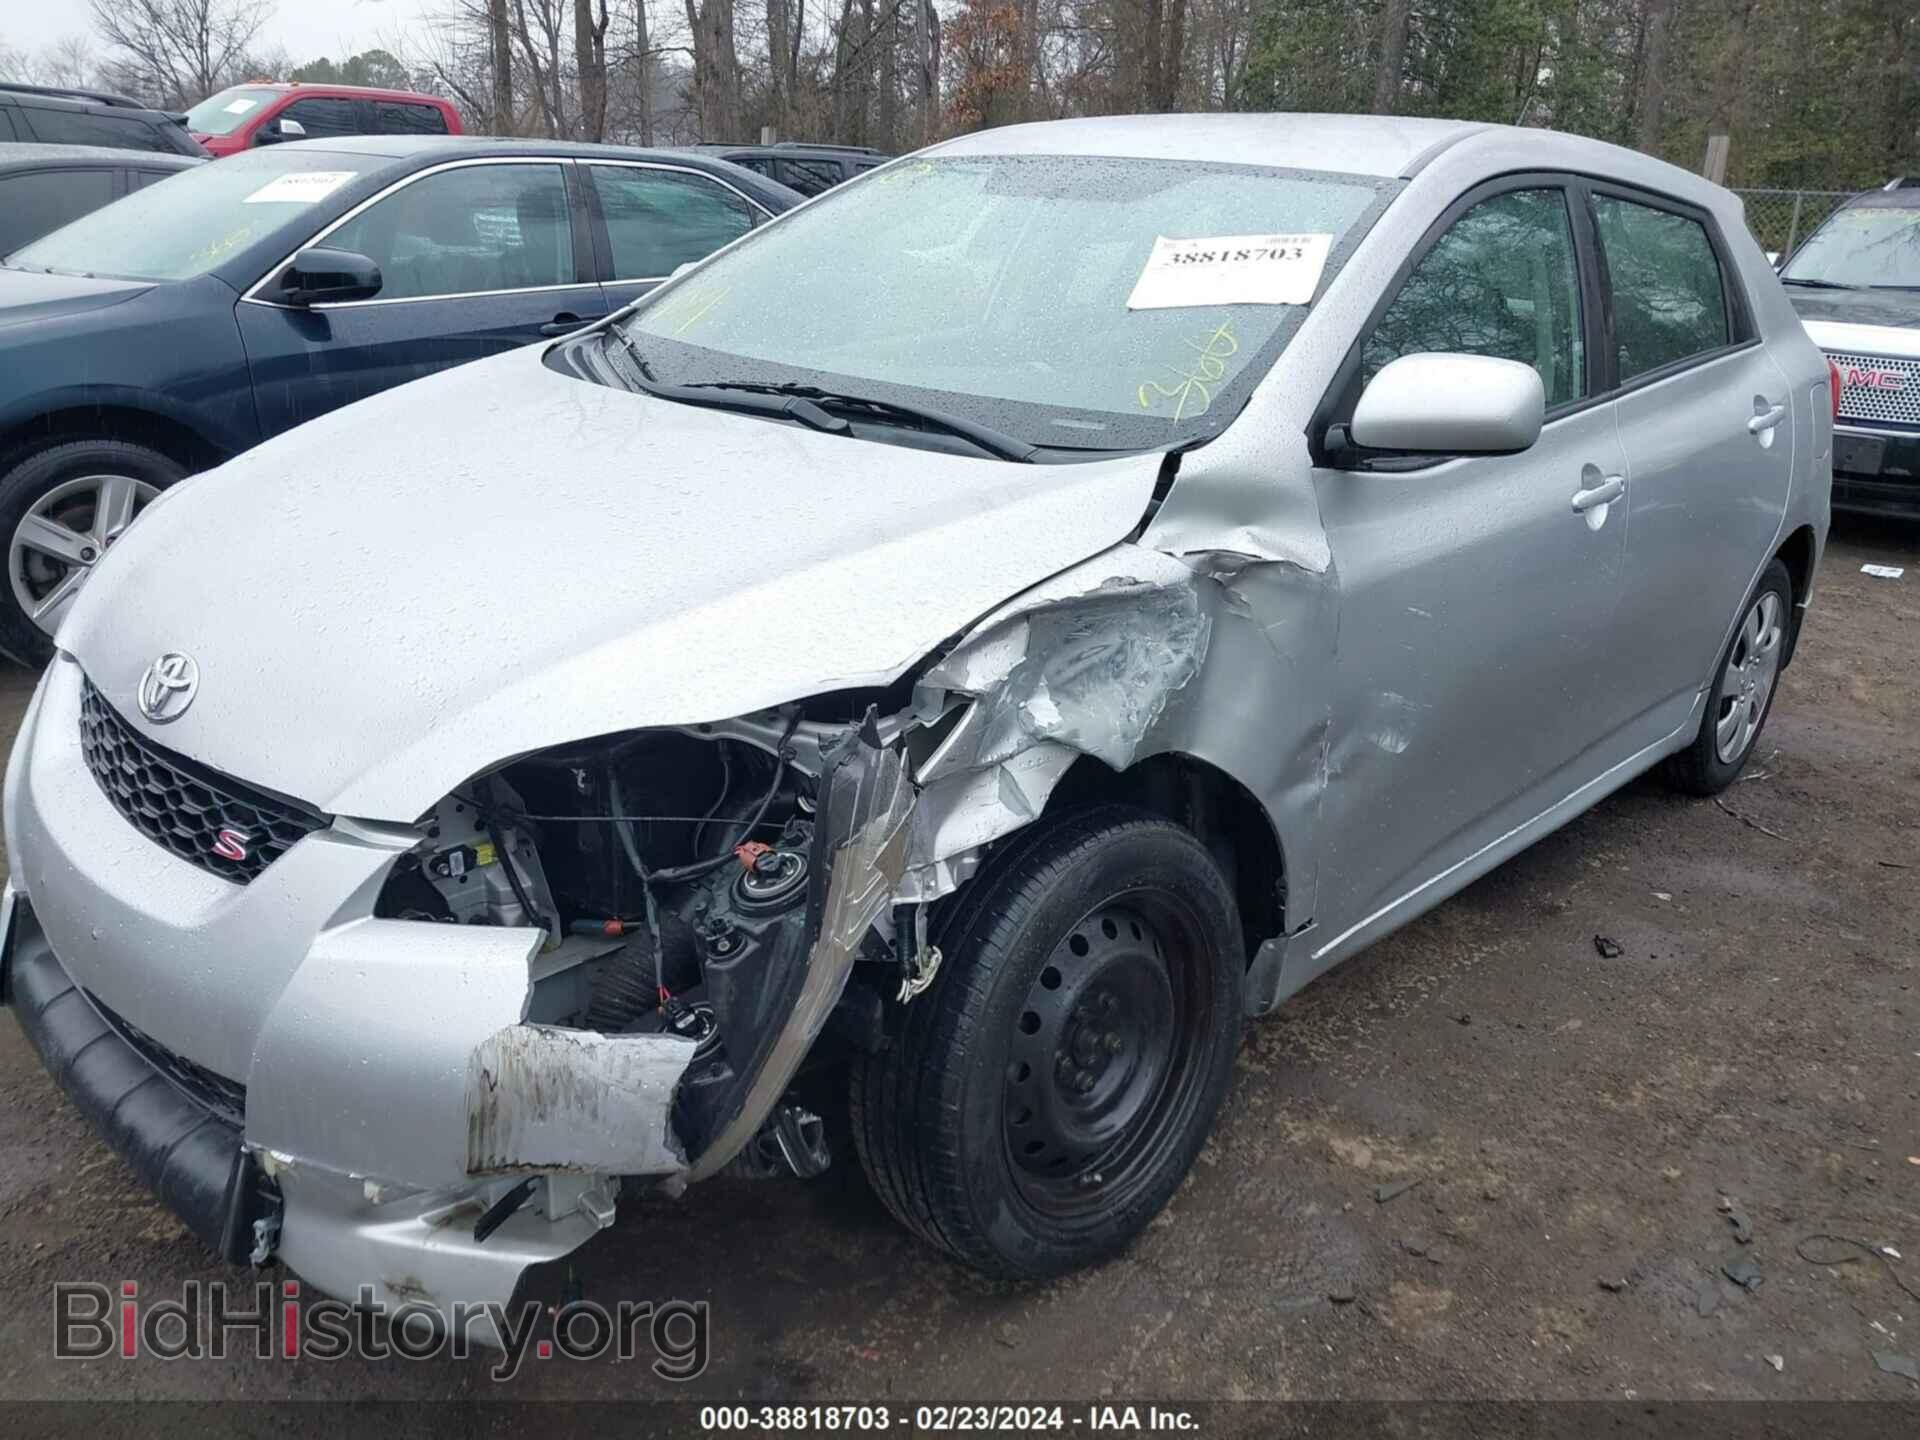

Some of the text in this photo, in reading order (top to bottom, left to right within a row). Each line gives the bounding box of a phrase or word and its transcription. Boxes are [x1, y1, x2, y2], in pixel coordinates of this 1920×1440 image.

[1163, 247, 1304, 266] 38818703
[1846, 368, 1905, 390] MC
[212, 829, 249, 861] S
